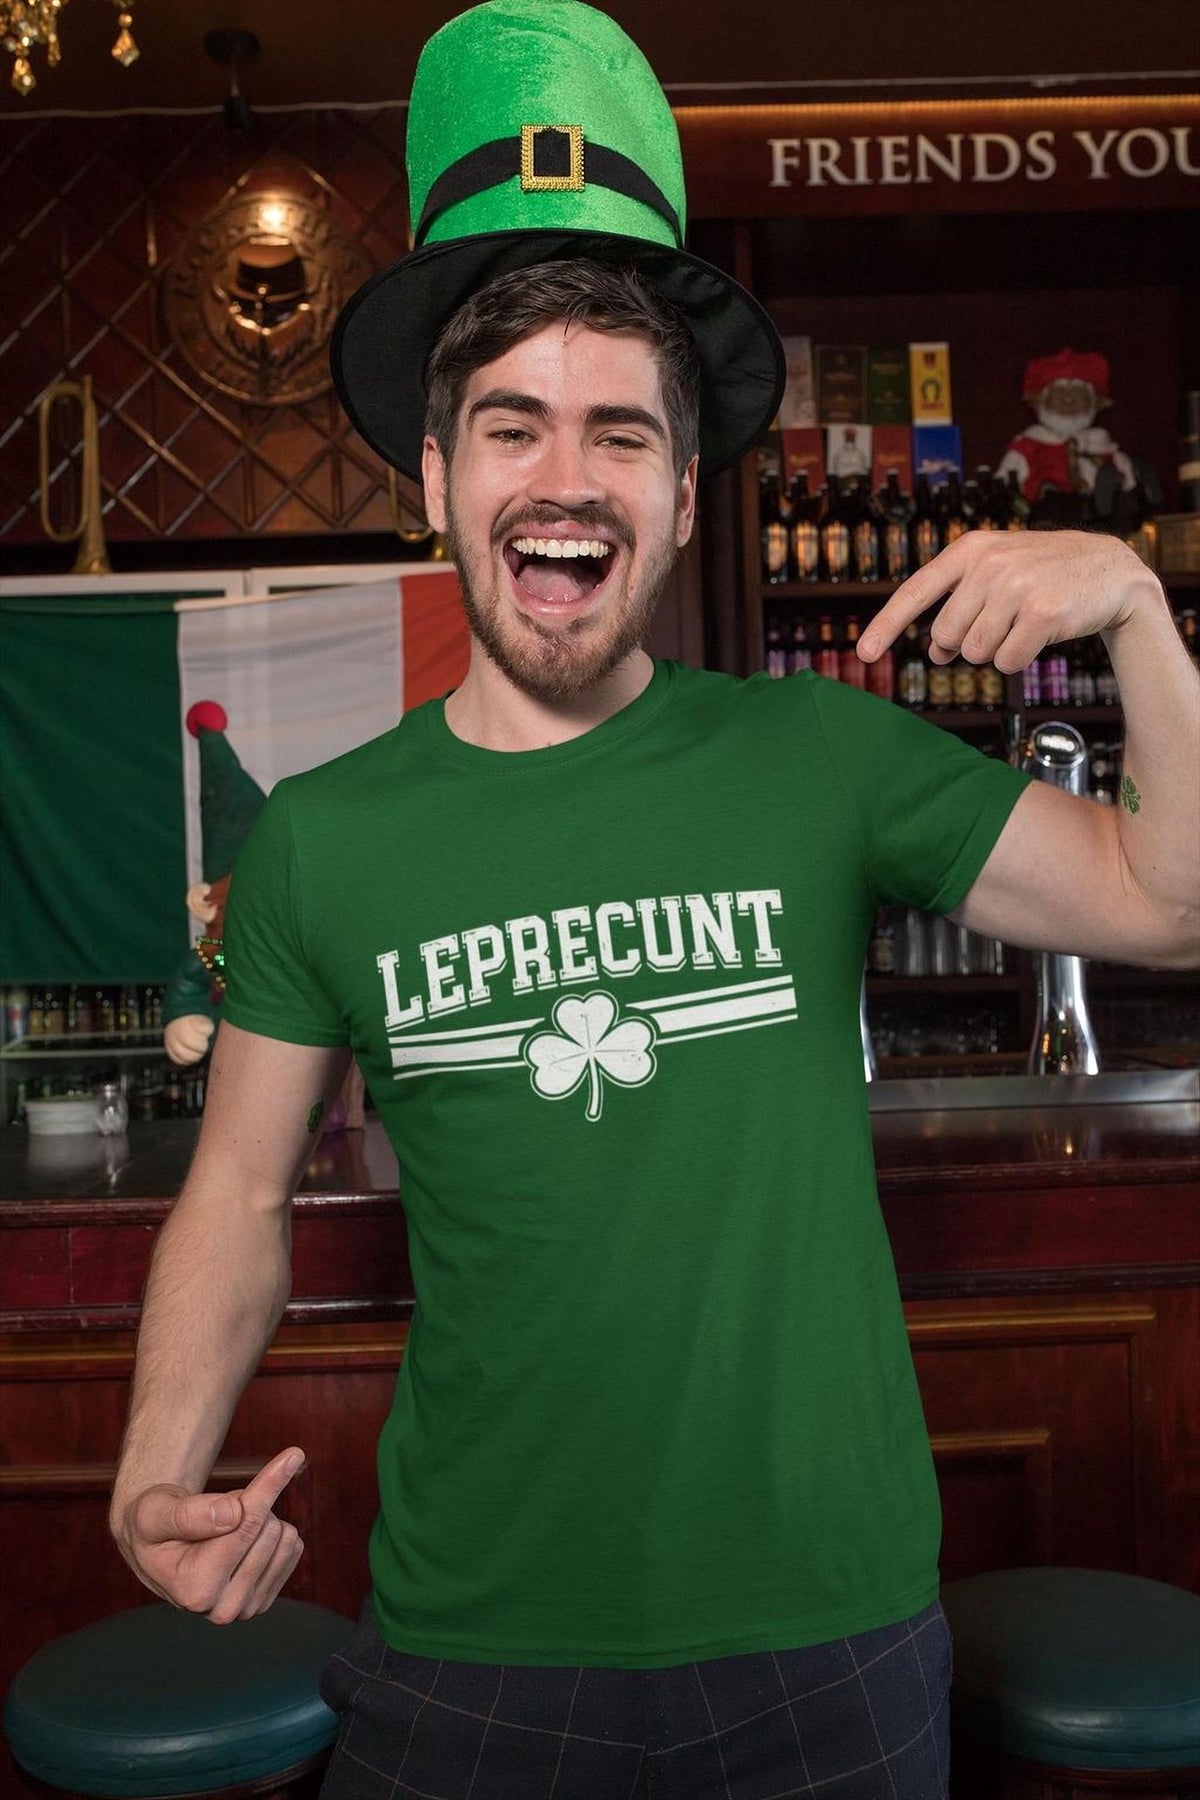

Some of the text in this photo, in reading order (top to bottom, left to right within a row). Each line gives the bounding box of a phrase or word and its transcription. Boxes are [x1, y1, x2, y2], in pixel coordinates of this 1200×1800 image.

[767, 126, 1200, 188] FRIENDS YOU
[376, 889, 784, 1032] LEPRECUNT
